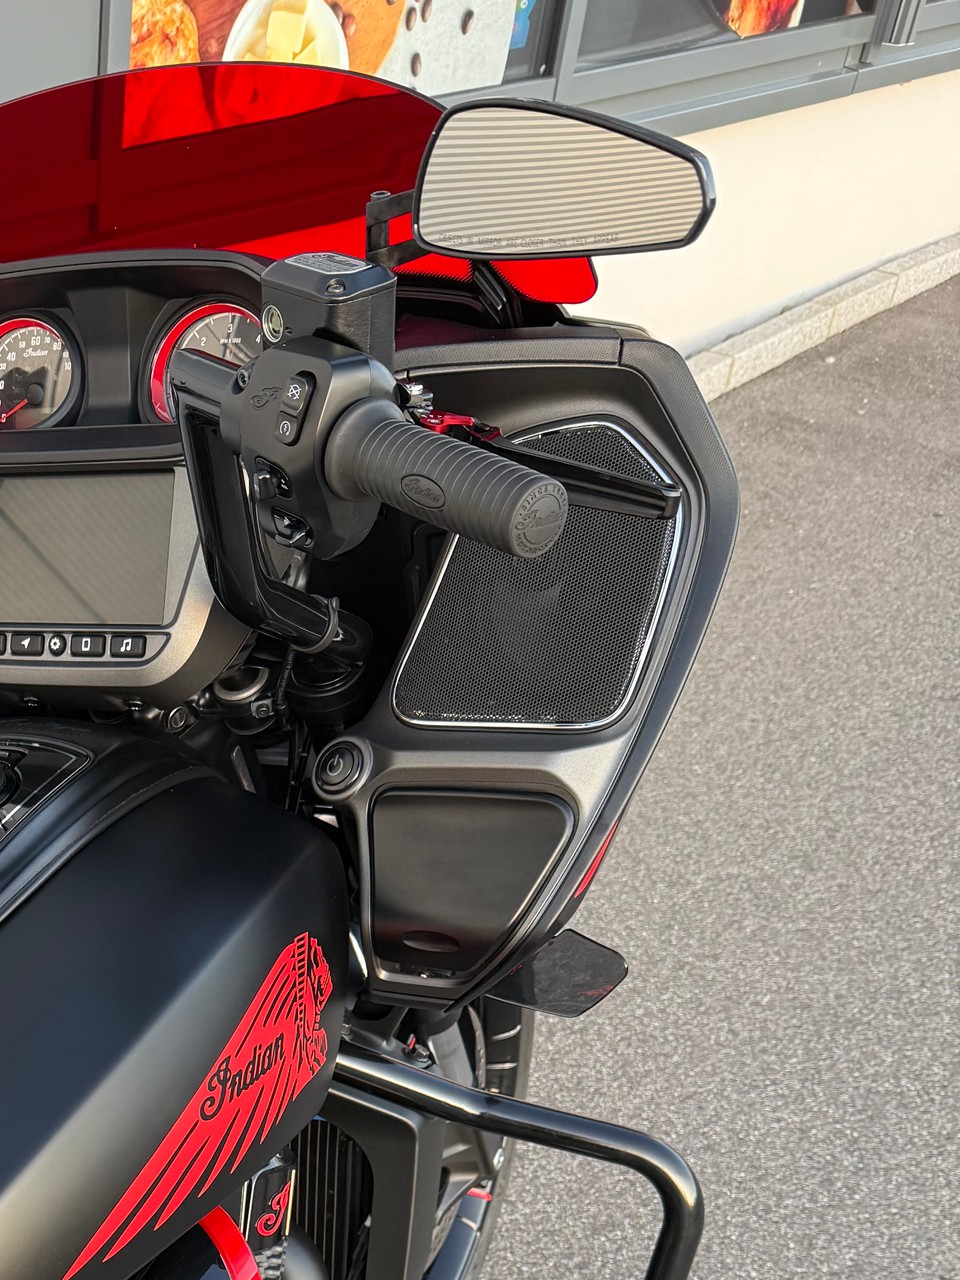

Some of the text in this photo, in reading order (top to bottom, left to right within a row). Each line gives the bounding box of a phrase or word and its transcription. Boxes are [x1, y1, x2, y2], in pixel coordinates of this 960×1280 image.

[227, 323, 233, 333] 3
[30, 336, 41, 346] 60
[43, 336, 51, 344] 70
[200, 337, 206, 347] 2
[255, 334, 261, 344] 4
[18, 341, 26, 349] 50
[52, 341, 62, 350] 80
[6, 352, 16, 362] 40
[23, 347, 49, 358] Indian
[0, 362, 7, 370] 30
[199, 1032, 285, 1121] Indian
